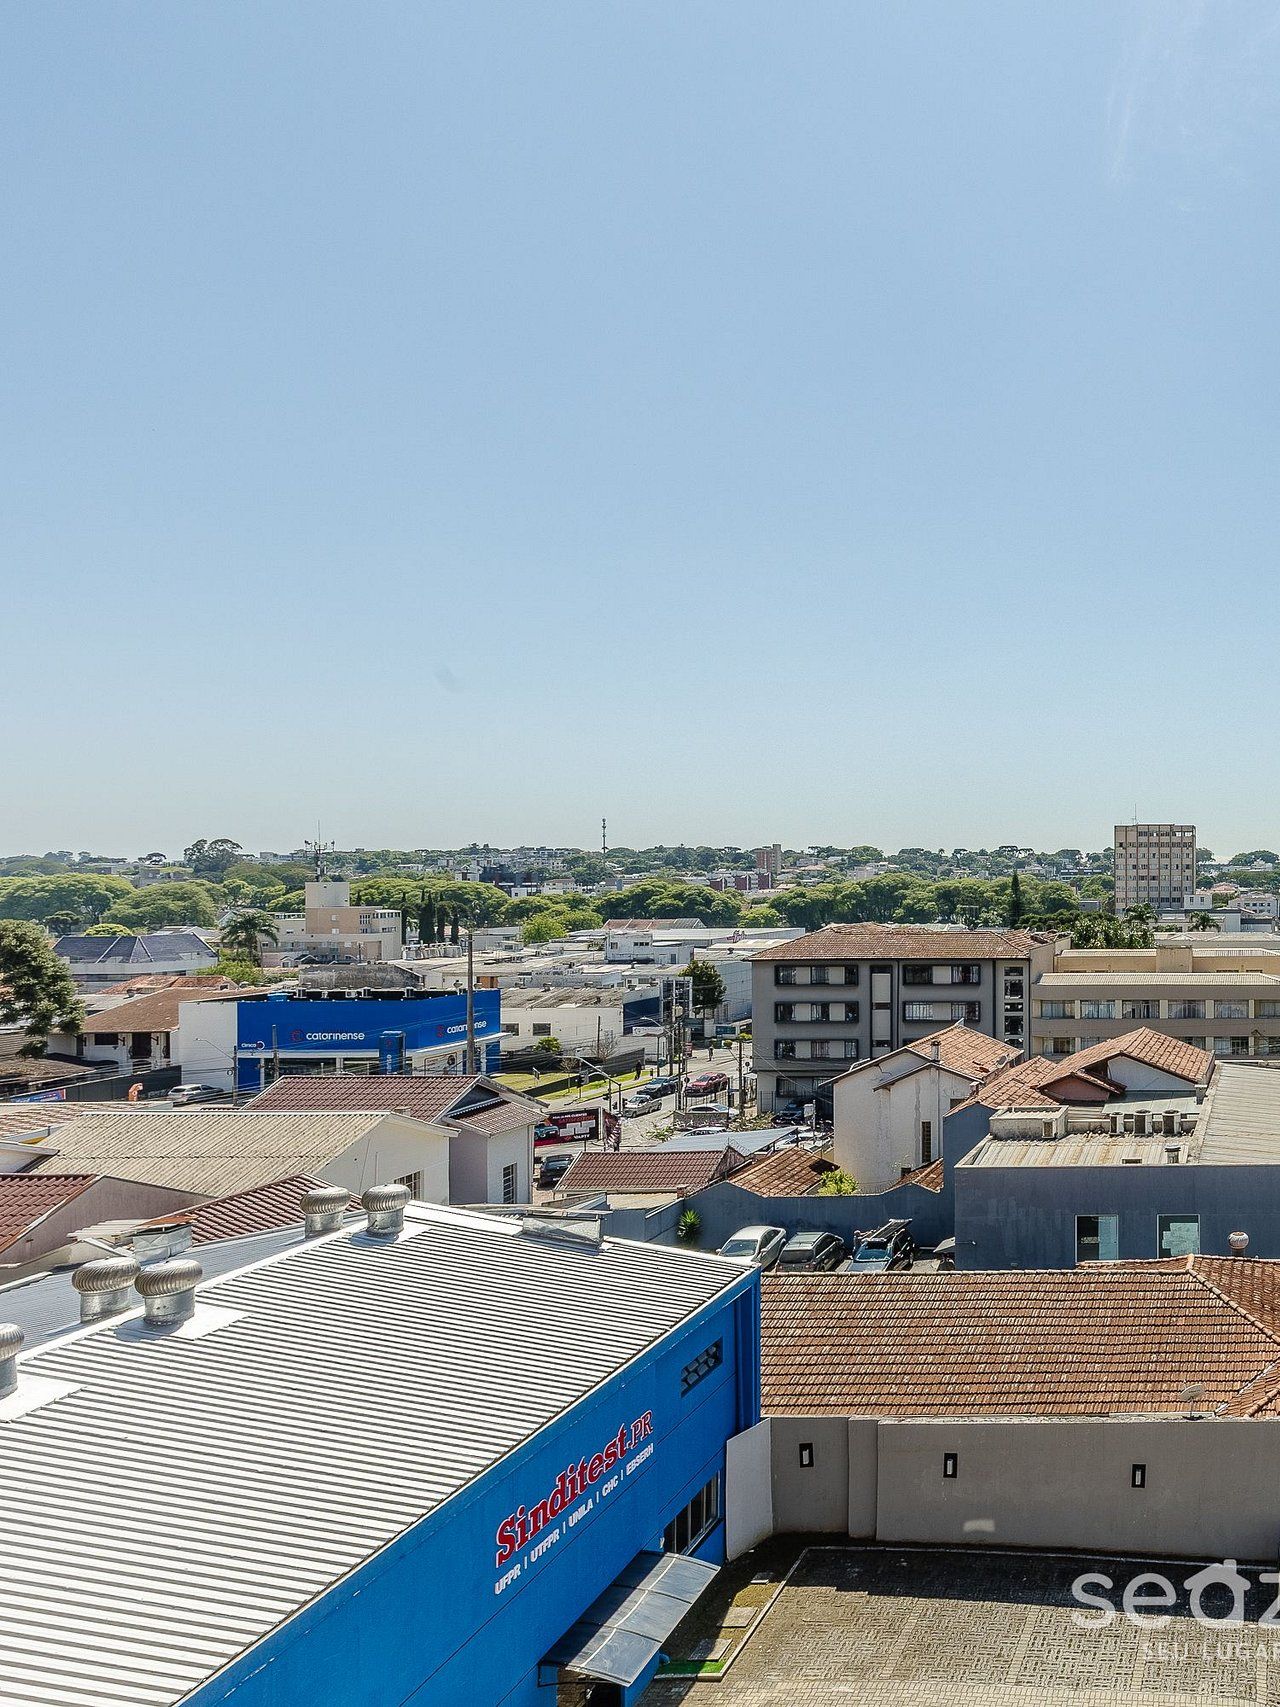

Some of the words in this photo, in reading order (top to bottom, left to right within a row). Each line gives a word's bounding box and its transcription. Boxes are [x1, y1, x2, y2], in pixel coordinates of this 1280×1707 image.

[306, 1031, 365, 1041] catarinense
[494, 1563, 521, 1595] UFPR
[530, 1528, 560, 1562] UTFPR
[568, 1498, 593, 1527] UNILA
[626, 1443, 654, 1476] EBSERH
